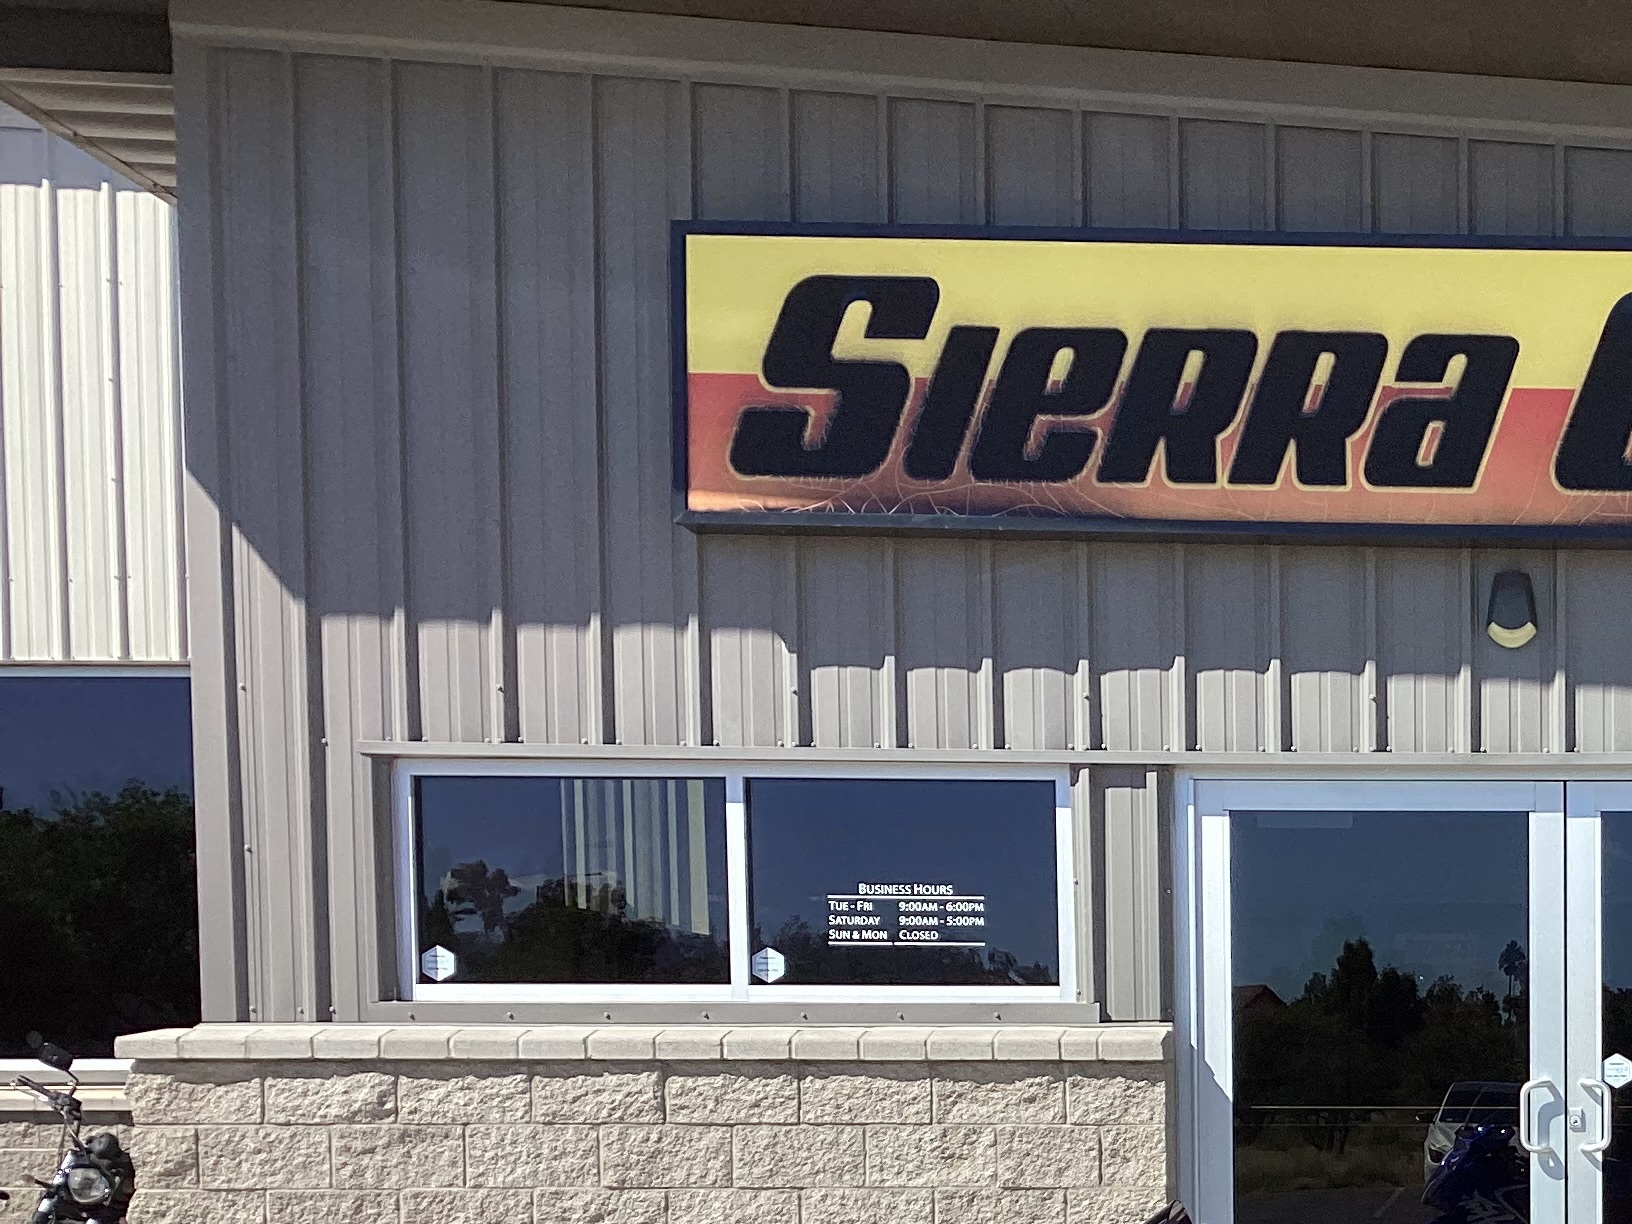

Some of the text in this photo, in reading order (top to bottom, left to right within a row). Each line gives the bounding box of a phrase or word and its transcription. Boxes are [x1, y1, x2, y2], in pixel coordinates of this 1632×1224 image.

[898, 901, 938, 912] 9:00AM
[945, 901, 985, 912] 6:00PM
[898, 915, 939, 926] 9:00AM
[945, 915, 985, 927] 5:00PM
[851, 930, 860, 940] &
